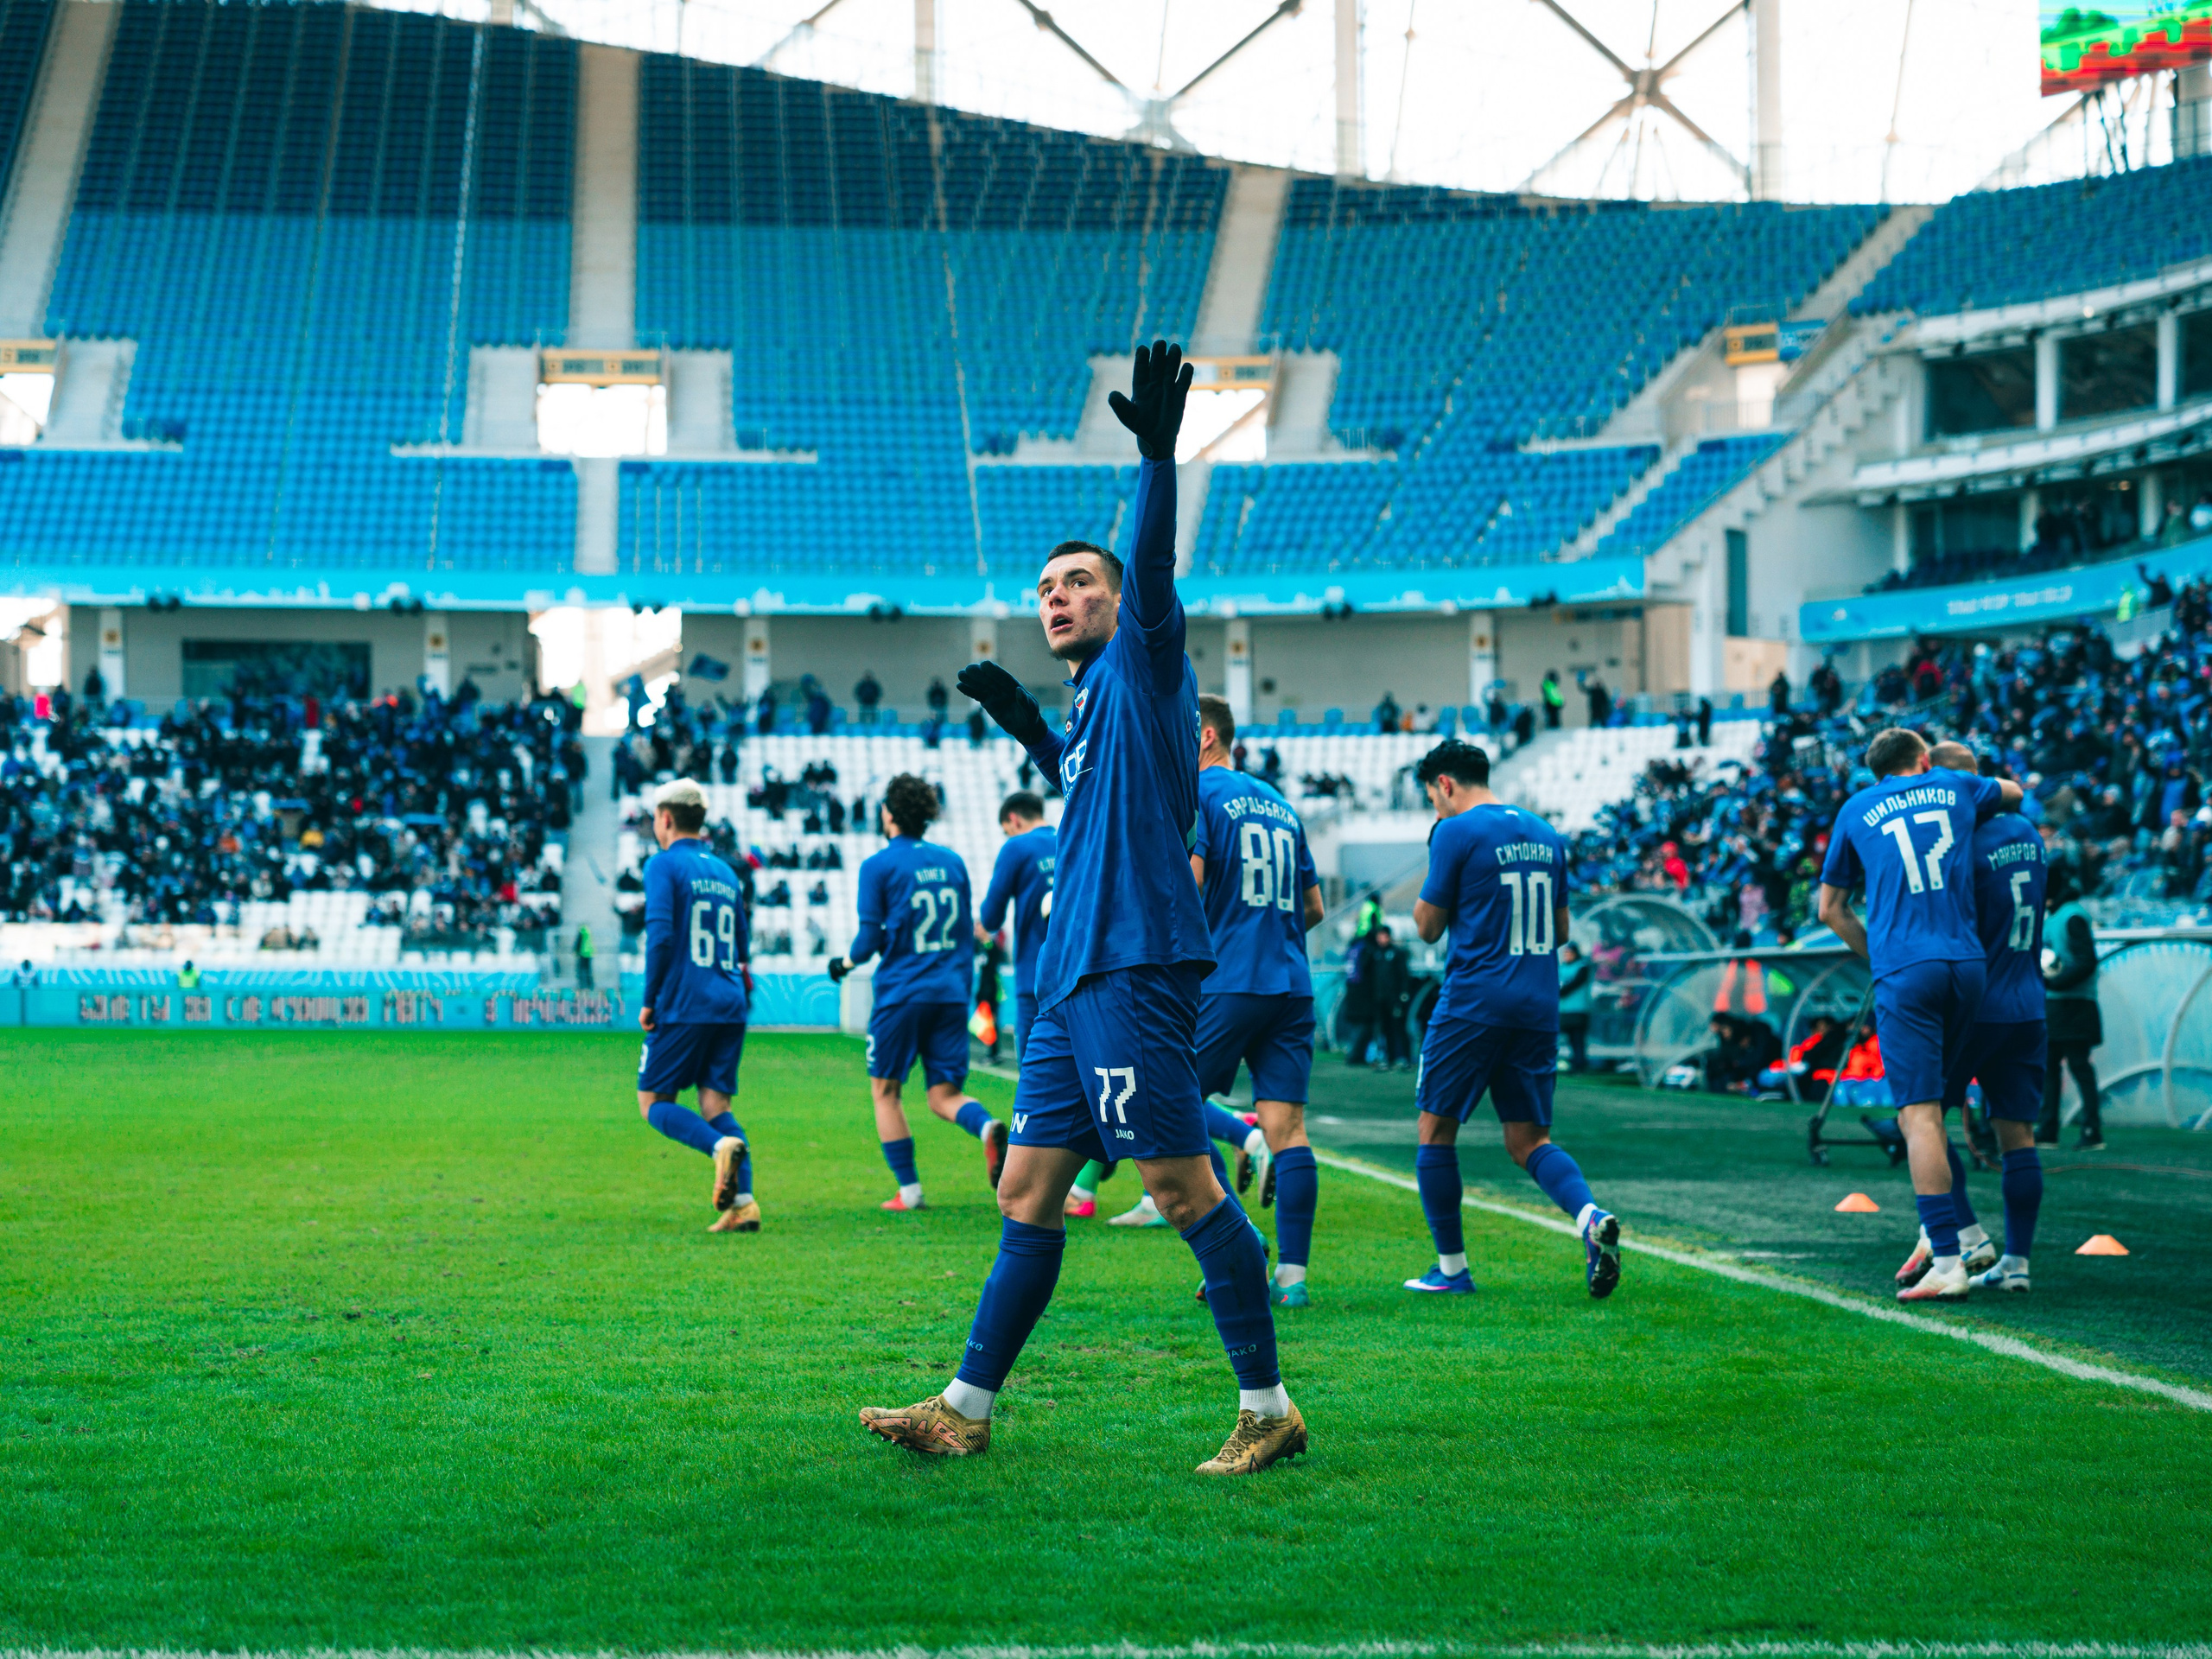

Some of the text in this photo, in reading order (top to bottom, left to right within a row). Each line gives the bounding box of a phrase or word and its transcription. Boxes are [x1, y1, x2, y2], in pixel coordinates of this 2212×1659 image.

[1863, 788, 1956, 828] ШИЛЬНИКОВ
[1240, 822, 1296, 912] 80
[1881, 810, 1955, 894] 17
[1987, 842, 2037, 871] МАКАРОВ
[690, 900, 734, 970] 69
[911, 887, 958, 953] 22
[1500, 871, 1554, 956] 10
[2008, 870, 2036, 951] 6
[1094, 1066, 1136, 1123] 77
[1115, 1128, 1135, 1141] JAKO
[1227, 1344, 1257, 1358] JAKO
